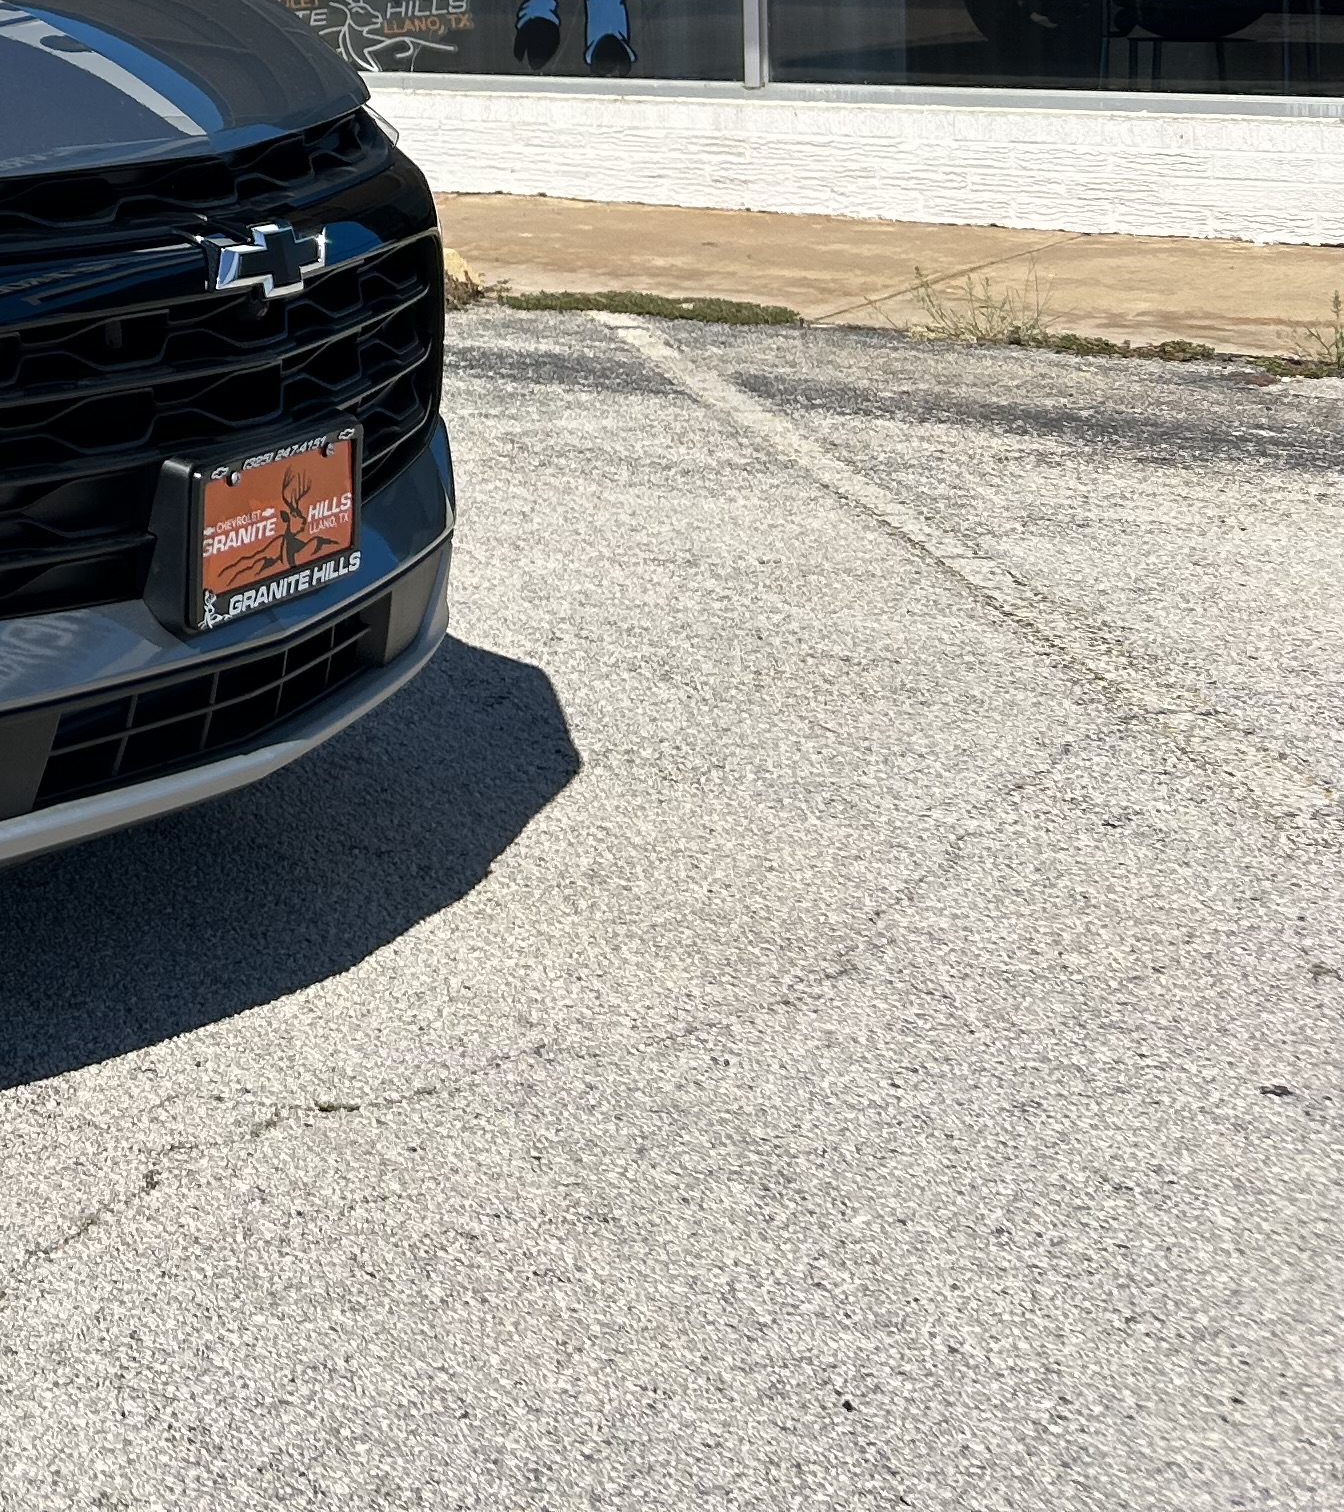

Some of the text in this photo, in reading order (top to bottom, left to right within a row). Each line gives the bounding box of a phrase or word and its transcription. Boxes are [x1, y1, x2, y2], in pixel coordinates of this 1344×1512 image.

[384, 13, 472, 34] LLANO, TX
[202, 492, 352, 557] GRANITE HILLS
[216, 509, 262, 534] CHEVROLET
[339, 512, 350, 524] TX
[229, 551, 361, 616] GRANITE HILLS
